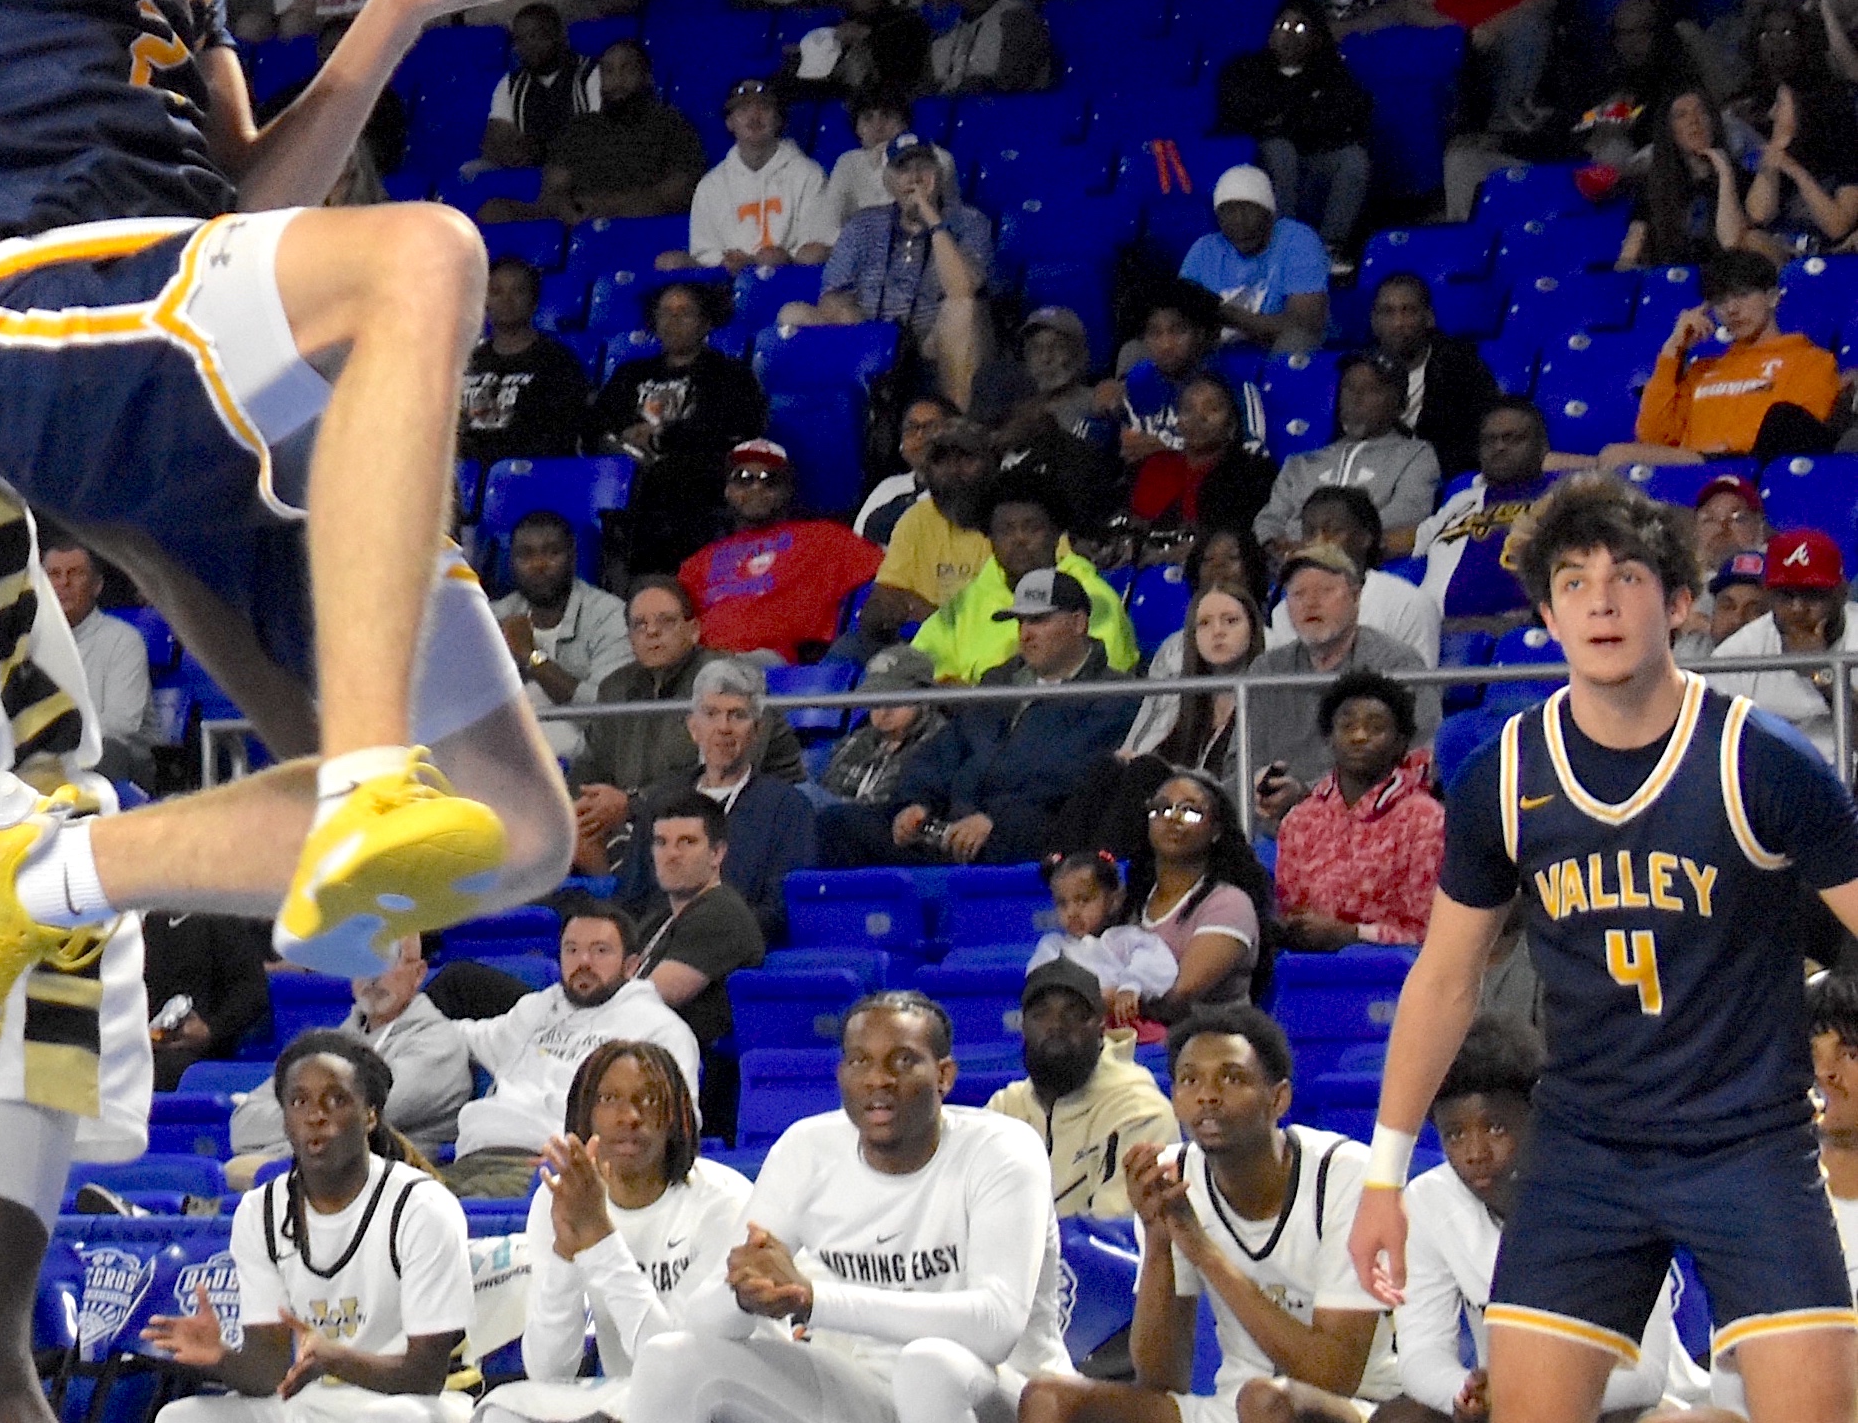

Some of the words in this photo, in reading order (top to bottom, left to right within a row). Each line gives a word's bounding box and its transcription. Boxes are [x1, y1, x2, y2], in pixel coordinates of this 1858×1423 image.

[737, 198, 782, 249] T
[1534, 850, 1718, 921] VALLEY
[1605, 929, 1663, 1016] 4
[819, 1250, 906, 1283] NOTHING
[912, 1245, 960, 1281] EASY
